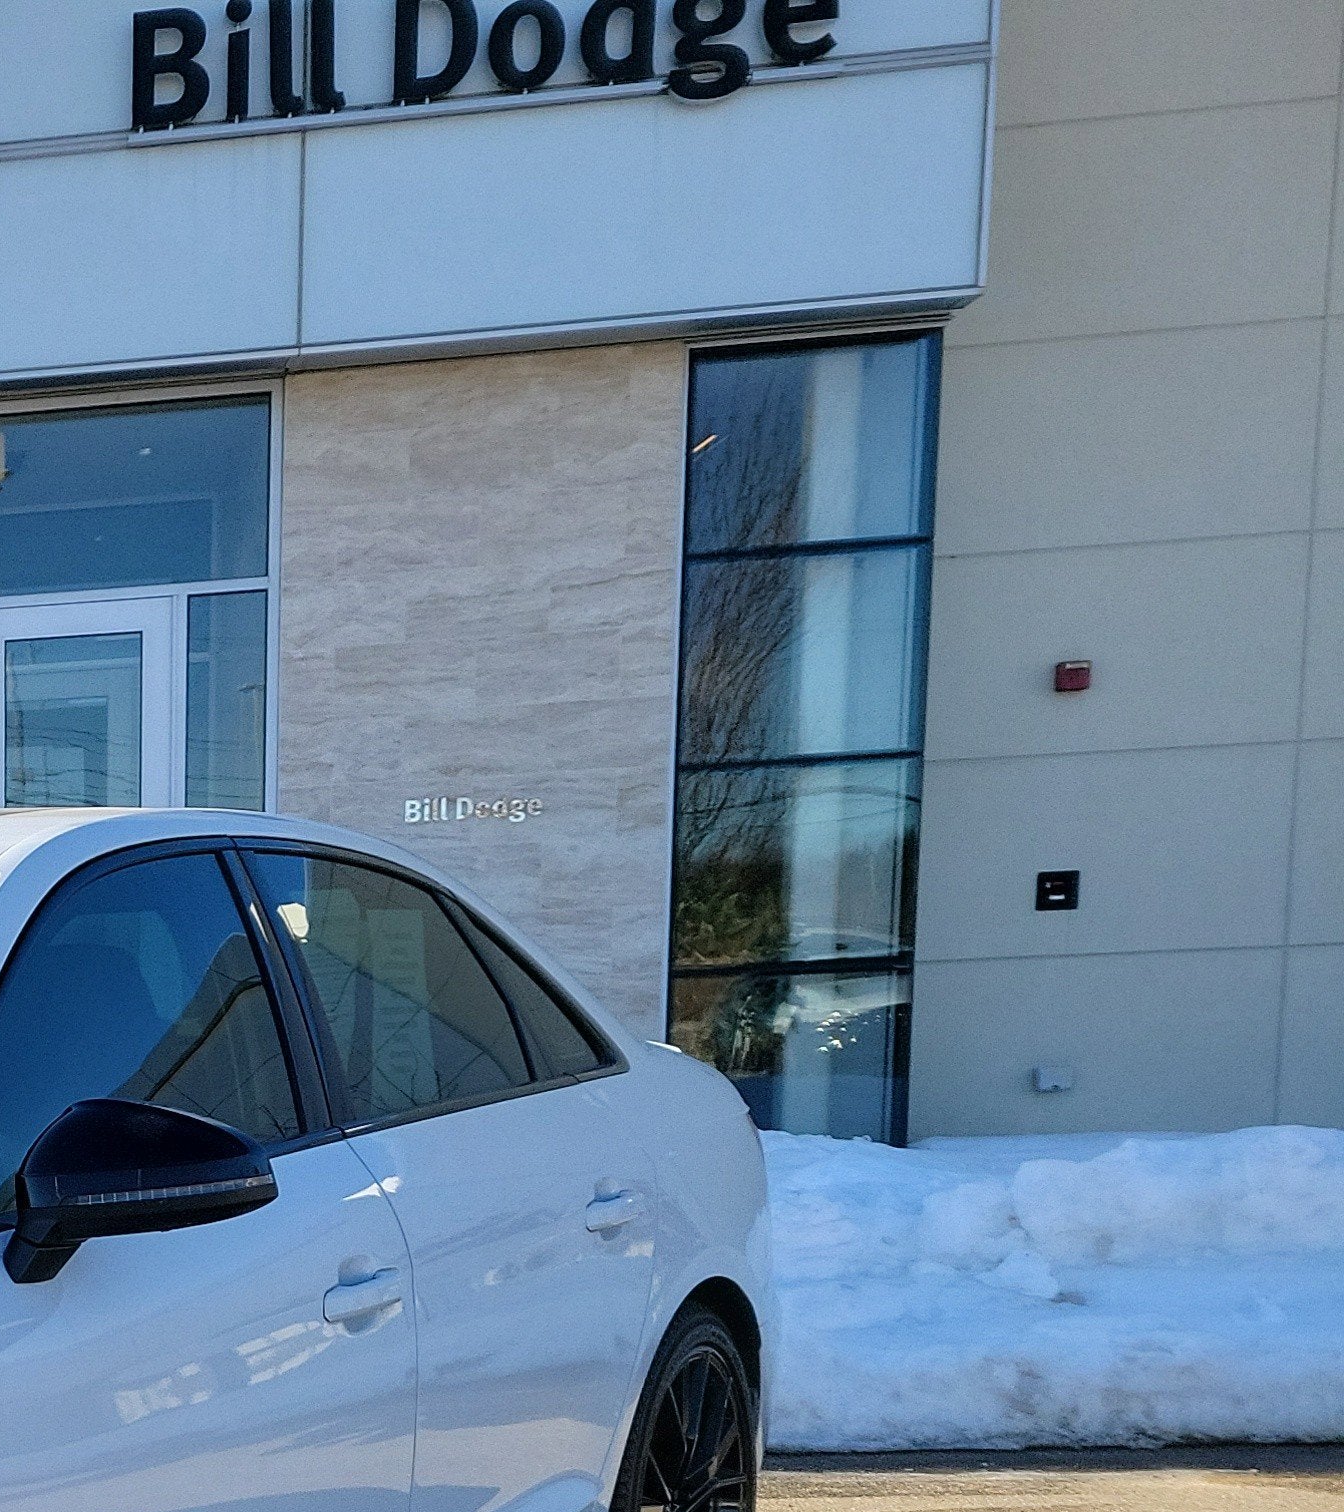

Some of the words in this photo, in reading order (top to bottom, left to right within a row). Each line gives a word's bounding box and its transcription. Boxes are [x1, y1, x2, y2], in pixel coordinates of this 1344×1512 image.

[131, 0, 346, 130] Bill
[404, 797, 449, 823] Bill
[455, 797, 544, 823] Dodge
